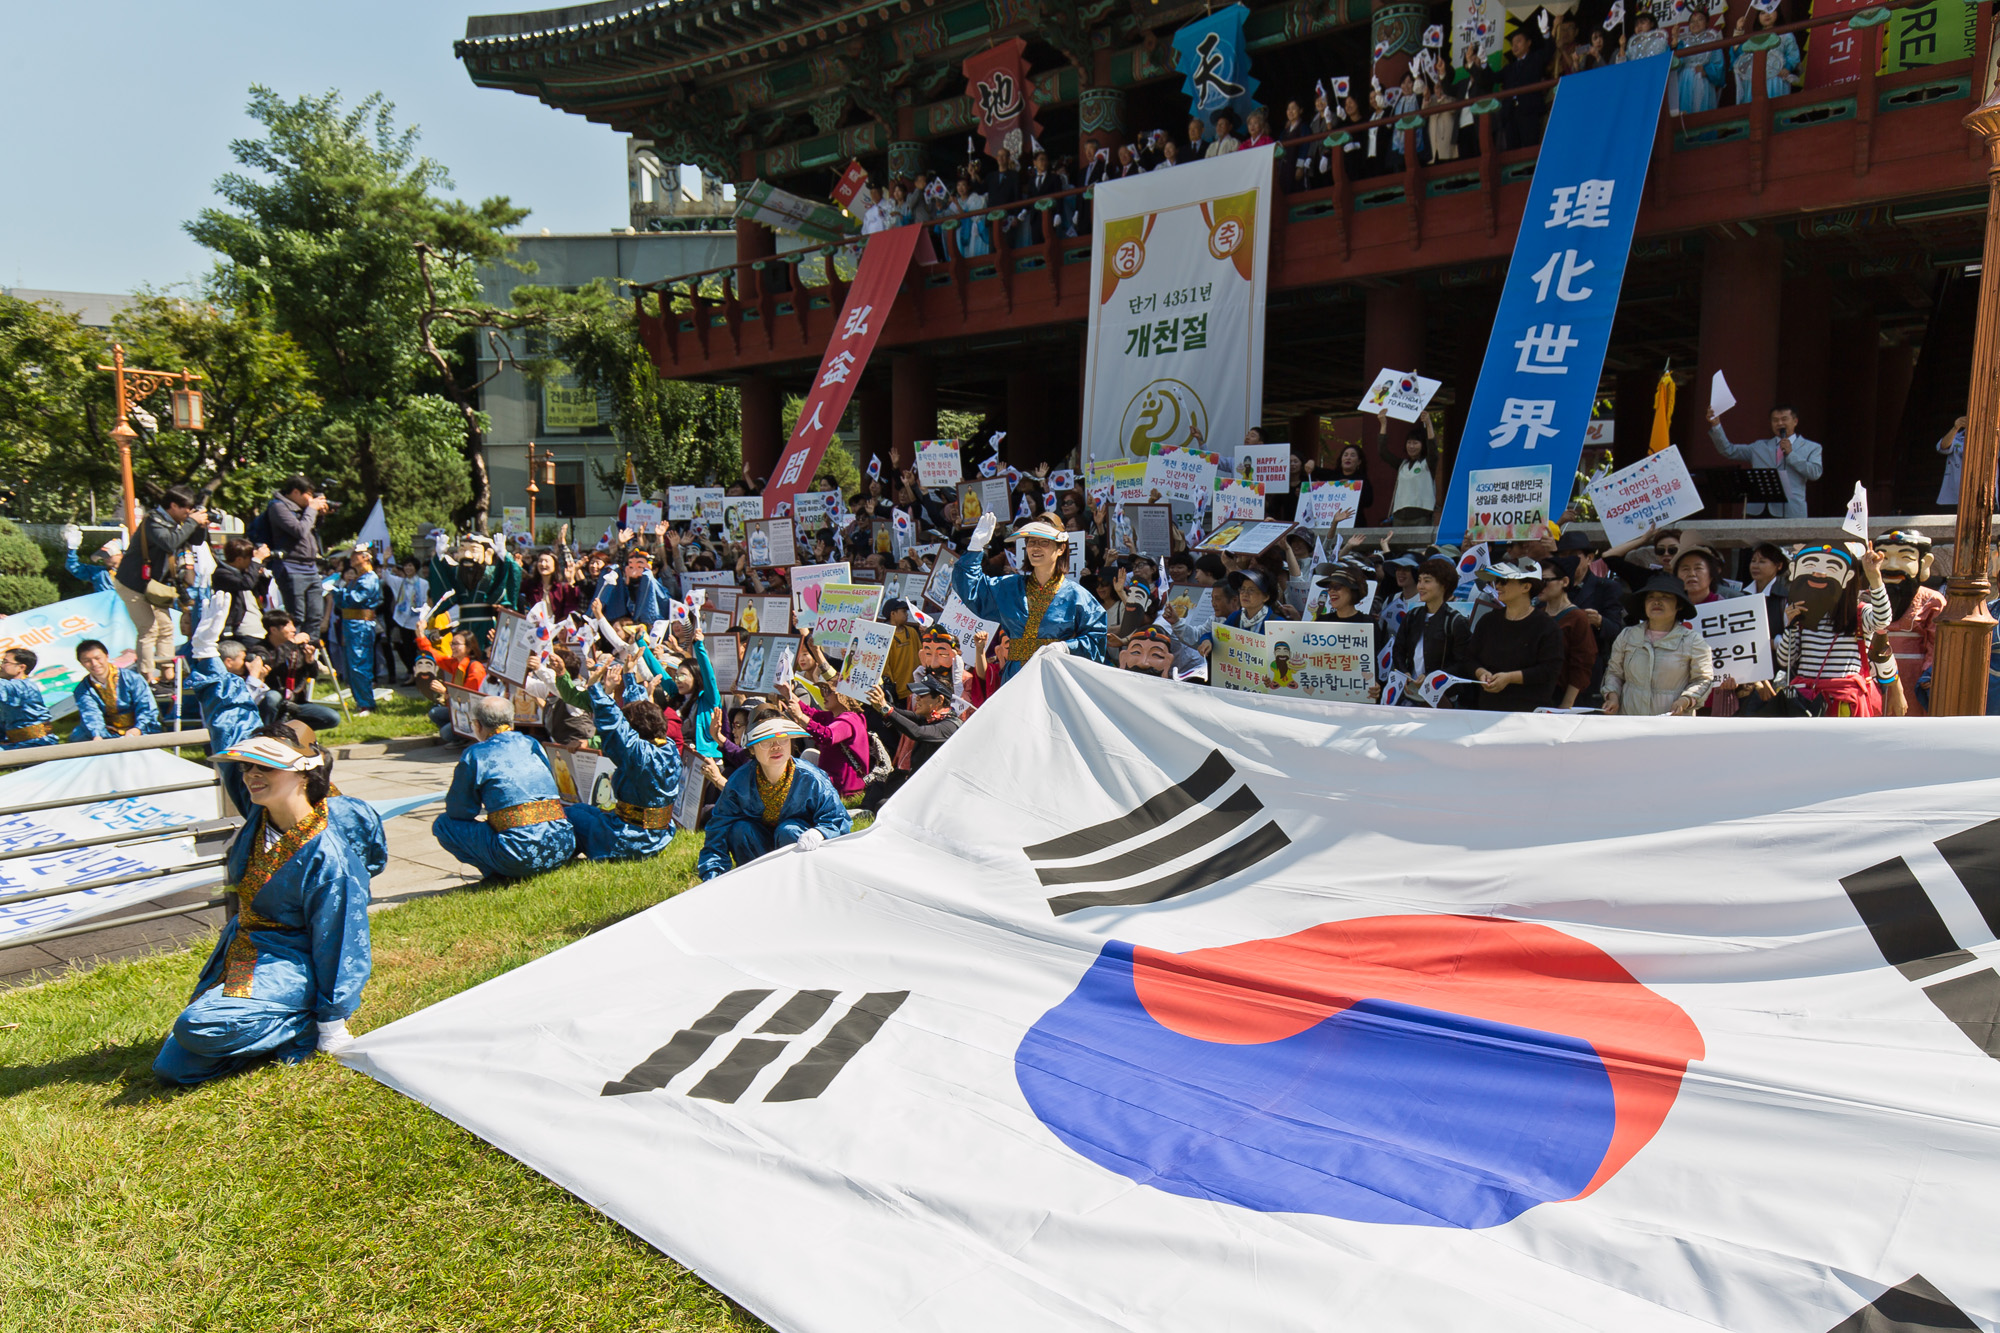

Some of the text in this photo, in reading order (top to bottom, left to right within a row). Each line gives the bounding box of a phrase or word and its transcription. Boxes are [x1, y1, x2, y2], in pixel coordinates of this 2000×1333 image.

[977, 72, 1025, 126] 地
[1120, 223, 1236, 270] 경 축
[1129, 282, 1213, 315] 단기 4351년
[1488, 179, 1615, 449] 理化世界
[1125, 312, 1209, 358] 개천절
[776, 304, 873, 488] 弘益人間
[1162, 458, 1178, 469] 개천
[1256, 457, 1277, 465] HAPPY
[1256, 465, 1287, 474] BIRTHDAY
[1151, 477, 1189, 490] 지구사랑의
[1166, 469, 1197, 482] 인간사랑
[1476, 478, 1543, 492] 4350번째 대한민국
[1619, 474, 1659, 497] 대한민국
[1606, 478, 1682, 519] 4350번째 생일을
[1493, 510, 1542, 525] KOREA
[1701, 610, 1756, 638] 단군
[1302, 633, 1368, 650] 4350번째
[1711, 641, 1758, 669] 홍익
[1300, 672, 1369, 692] 축하합니다
